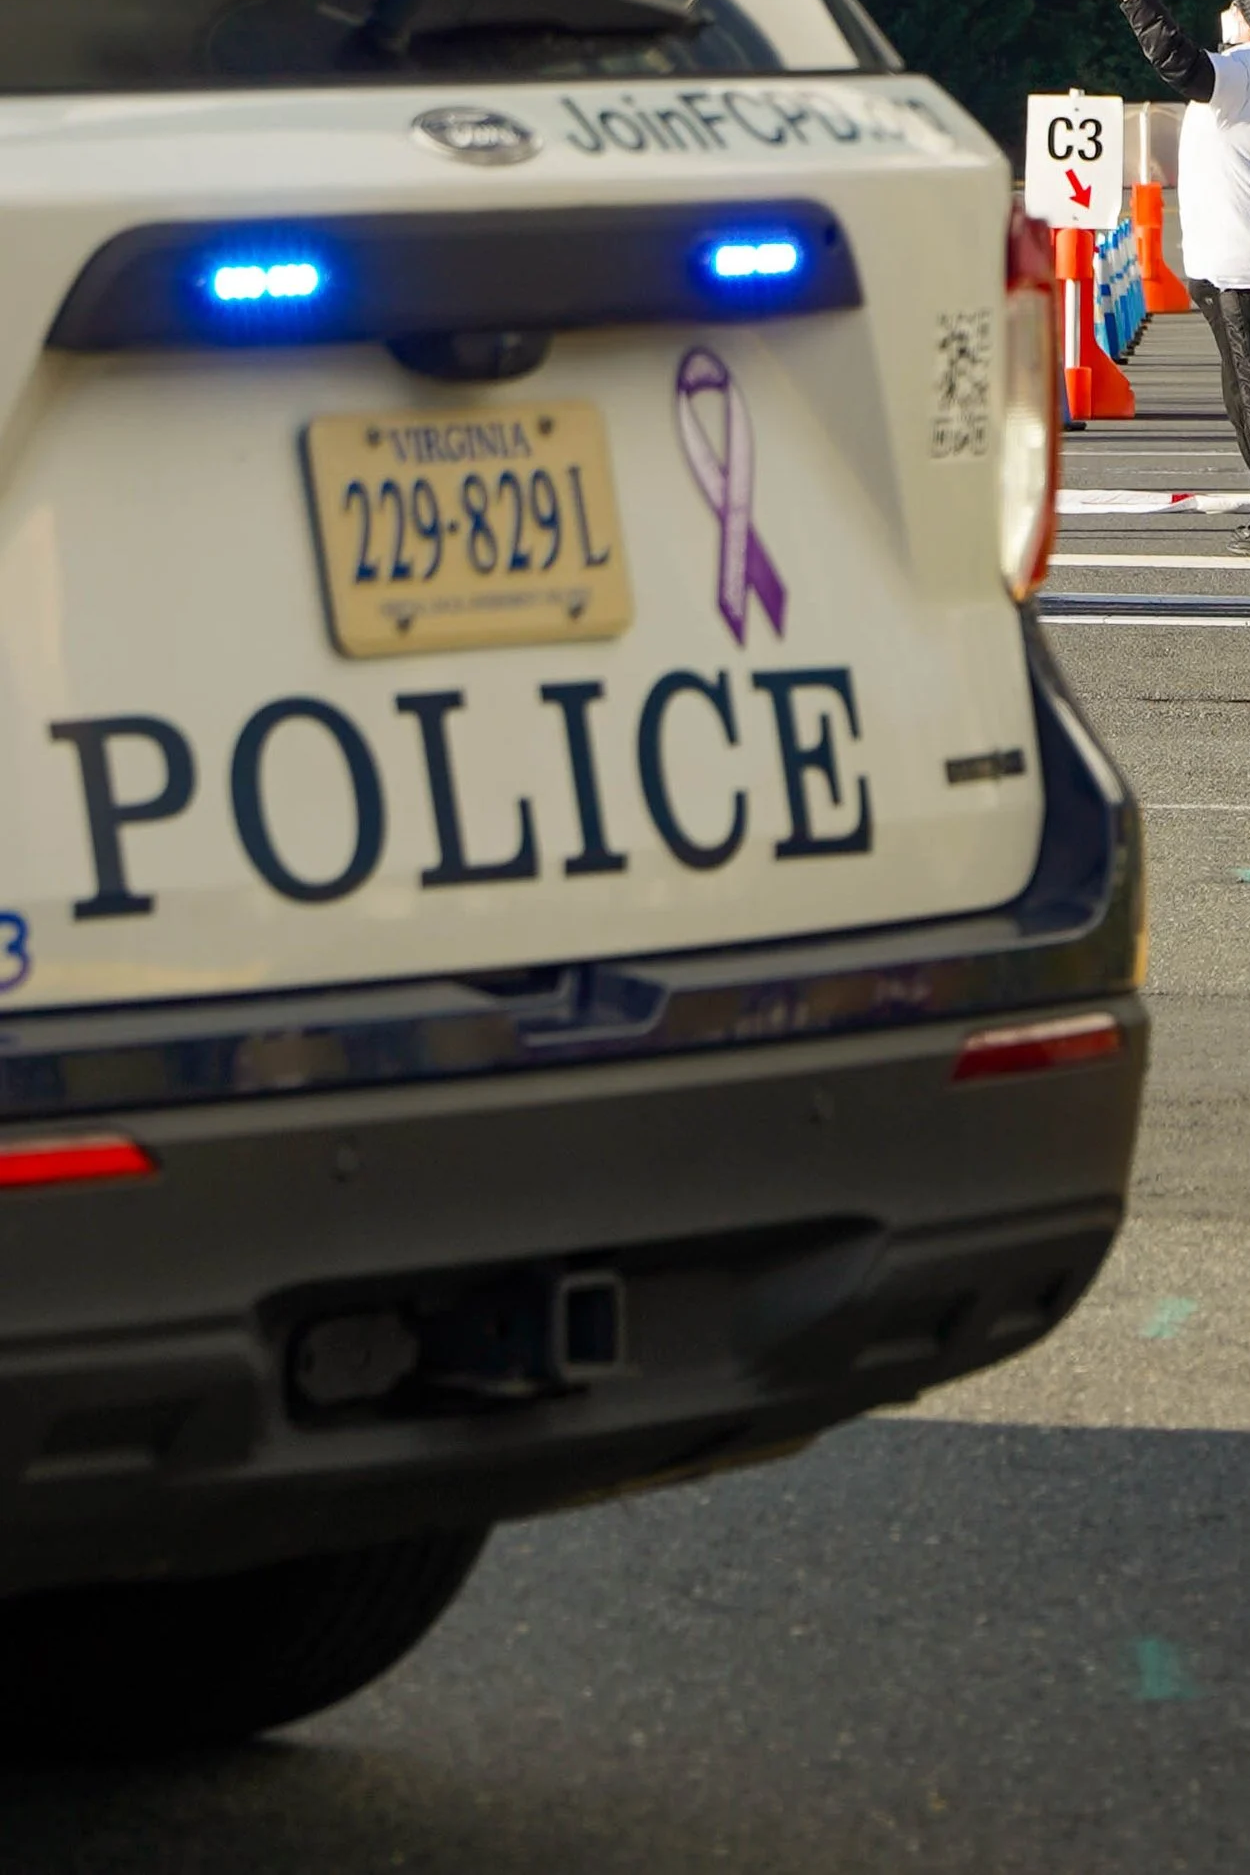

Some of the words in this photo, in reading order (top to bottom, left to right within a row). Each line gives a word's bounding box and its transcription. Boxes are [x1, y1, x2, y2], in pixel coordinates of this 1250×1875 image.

[1048, 117, 1104, 161] C3
[388, 421, 532, 464] VIRGINIA
[51, 665, 874, 922] POLICE
